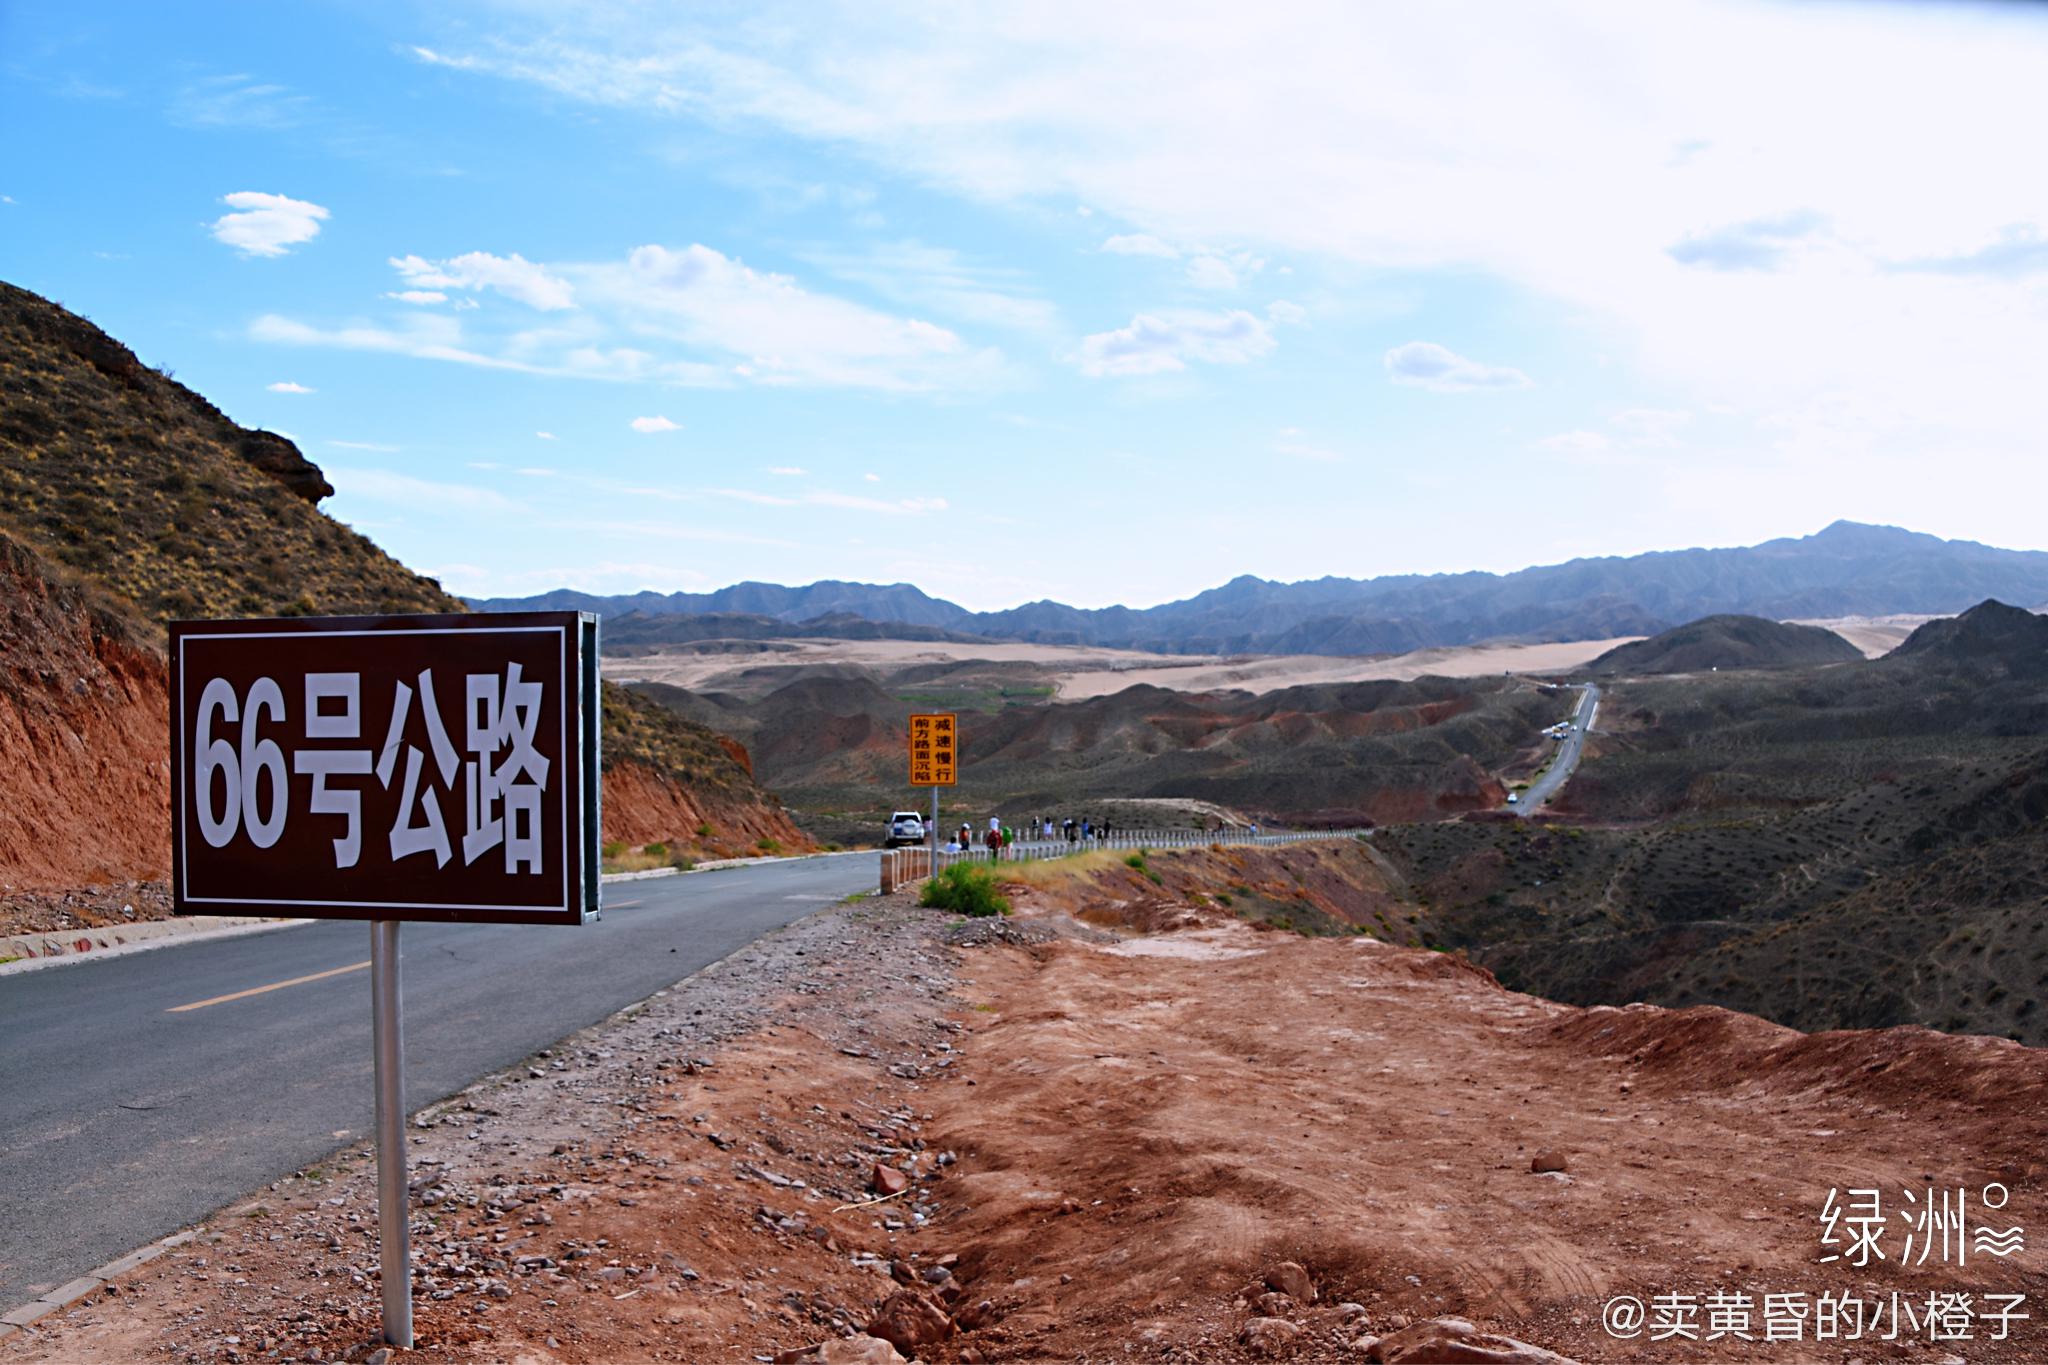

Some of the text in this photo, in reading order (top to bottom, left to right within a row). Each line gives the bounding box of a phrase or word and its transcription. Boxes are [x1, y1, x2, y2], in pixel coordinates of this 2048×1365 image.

[195, 661, 550, 875] 66号公路
[935, 718, 952, 781] 减速慢行
